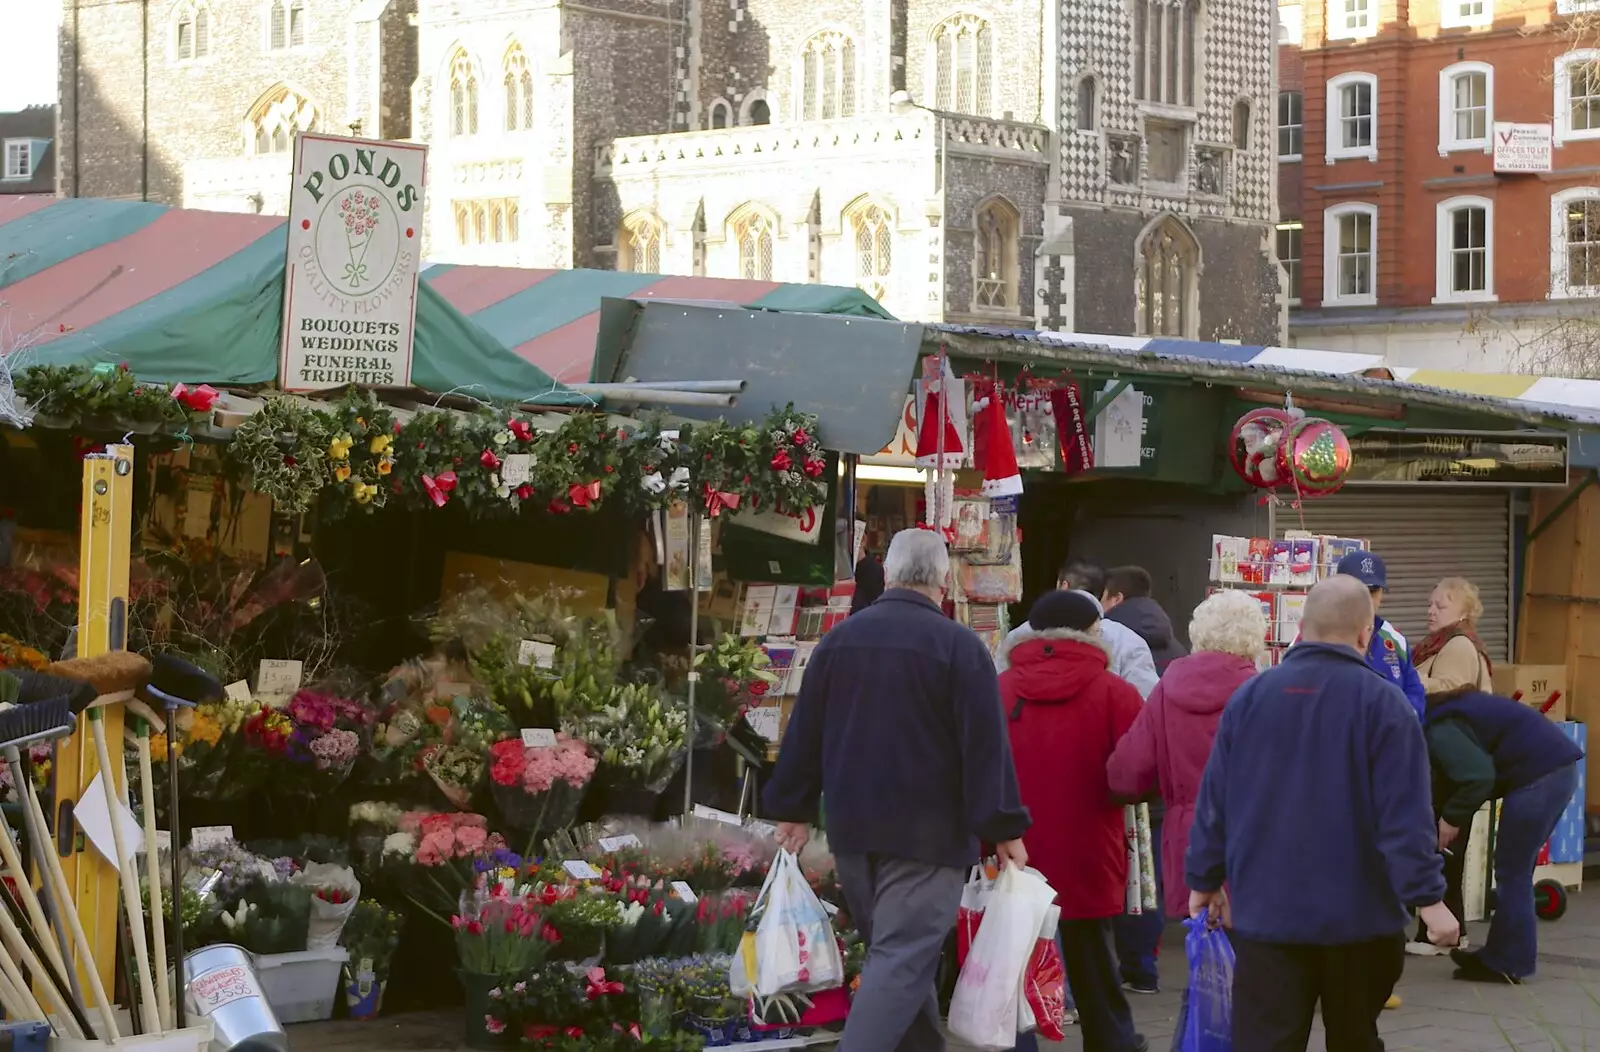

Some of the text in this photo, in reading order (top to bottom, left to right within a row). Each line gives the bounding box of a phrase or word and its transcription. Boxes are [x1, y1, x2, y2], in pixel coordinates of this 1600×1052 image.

[303, 148, 419, 212] PONDS
[300, 245, 412, 315] QUALITY FLOWERS
[301, 318, 400, 336] BOUQUETS
[301, 336, 398, 352] WEDDINGS
[304, 354, 392, 370] FUNERAL
[300, 369, 394, 385] TRIBUTES
[1072, 409, 1081, 421] be
[1076, 422, 1083, 433] to
[1424, 435, 1482, 454] NORWICH
[1531, 679, 1548, 692] SYY
